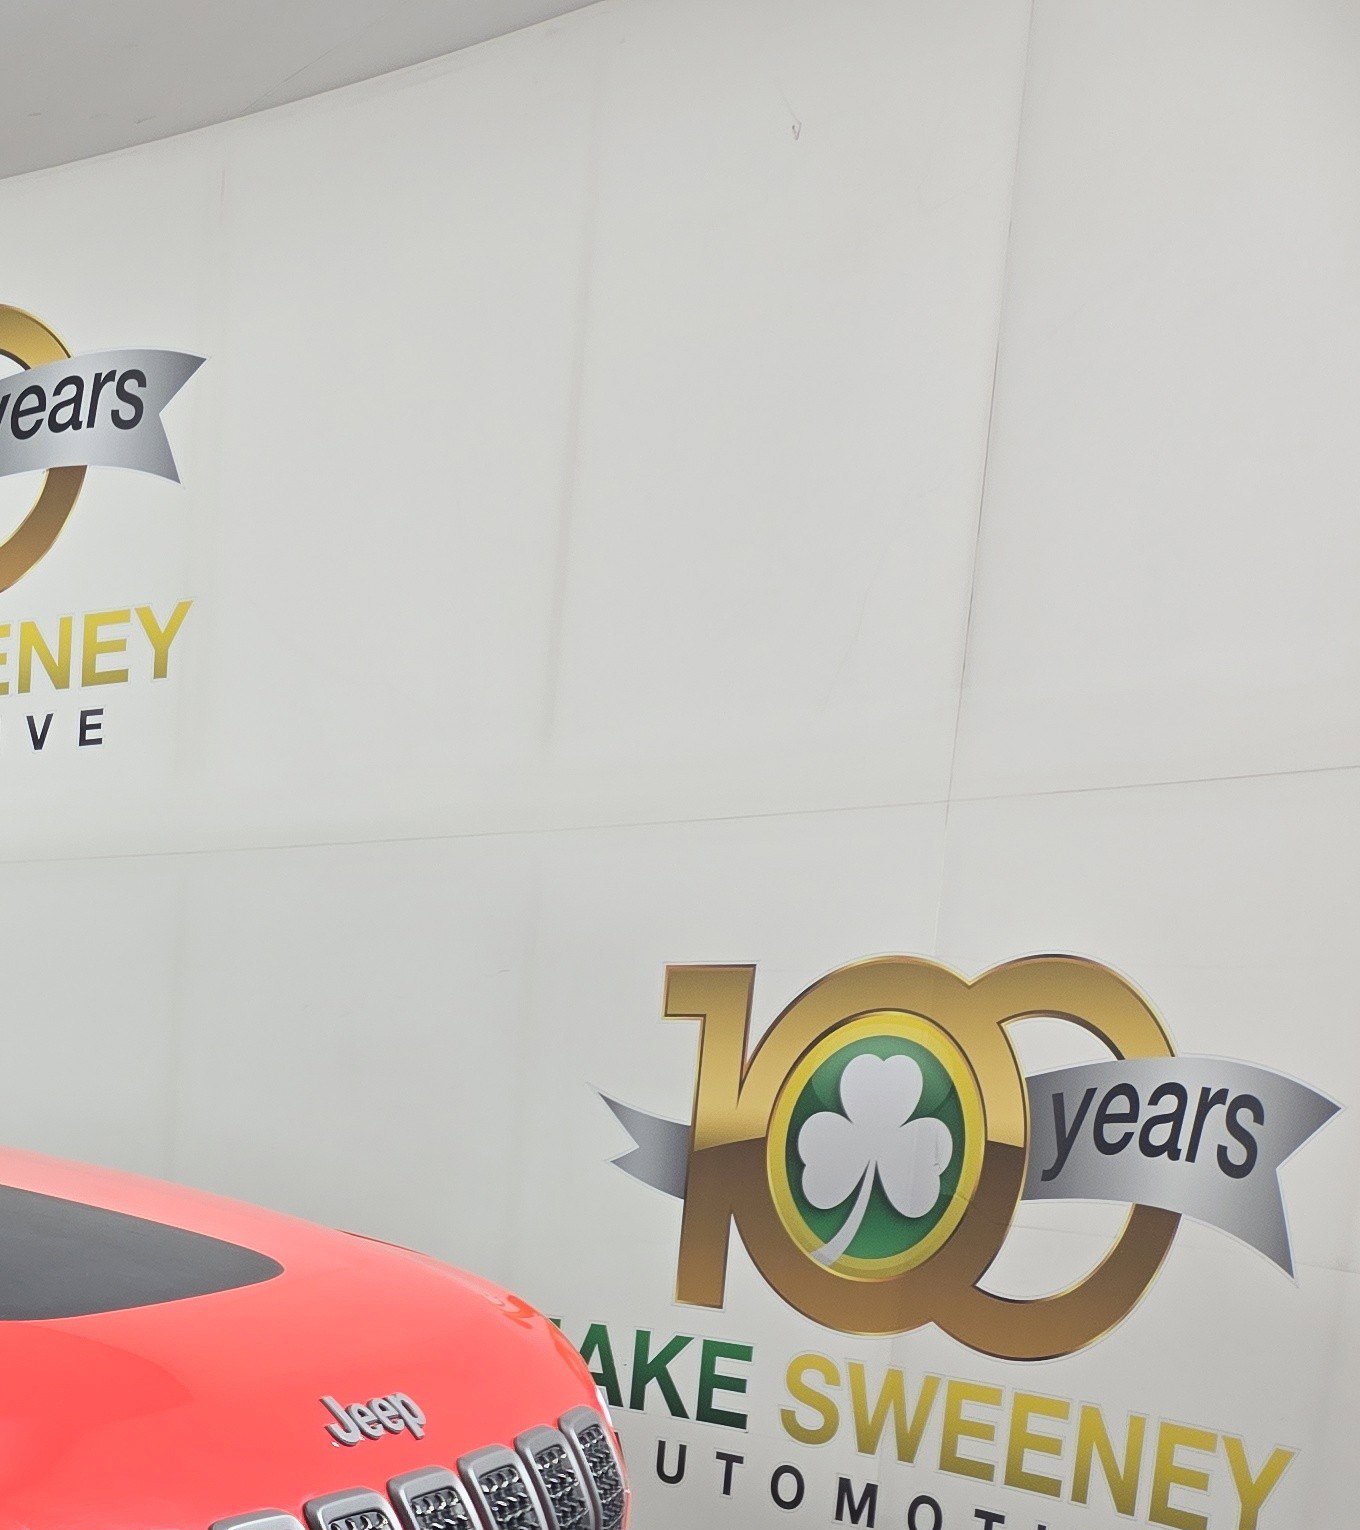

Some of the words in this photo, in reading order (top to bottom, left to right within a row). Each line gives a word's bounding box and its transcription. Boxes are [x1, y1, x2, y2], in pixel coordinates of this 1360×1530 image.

[1040, 1081, 1265, 1182] years
[319, 1391, 427, 1447] Jeep
[549, 1318, 754, 1431] AKE
